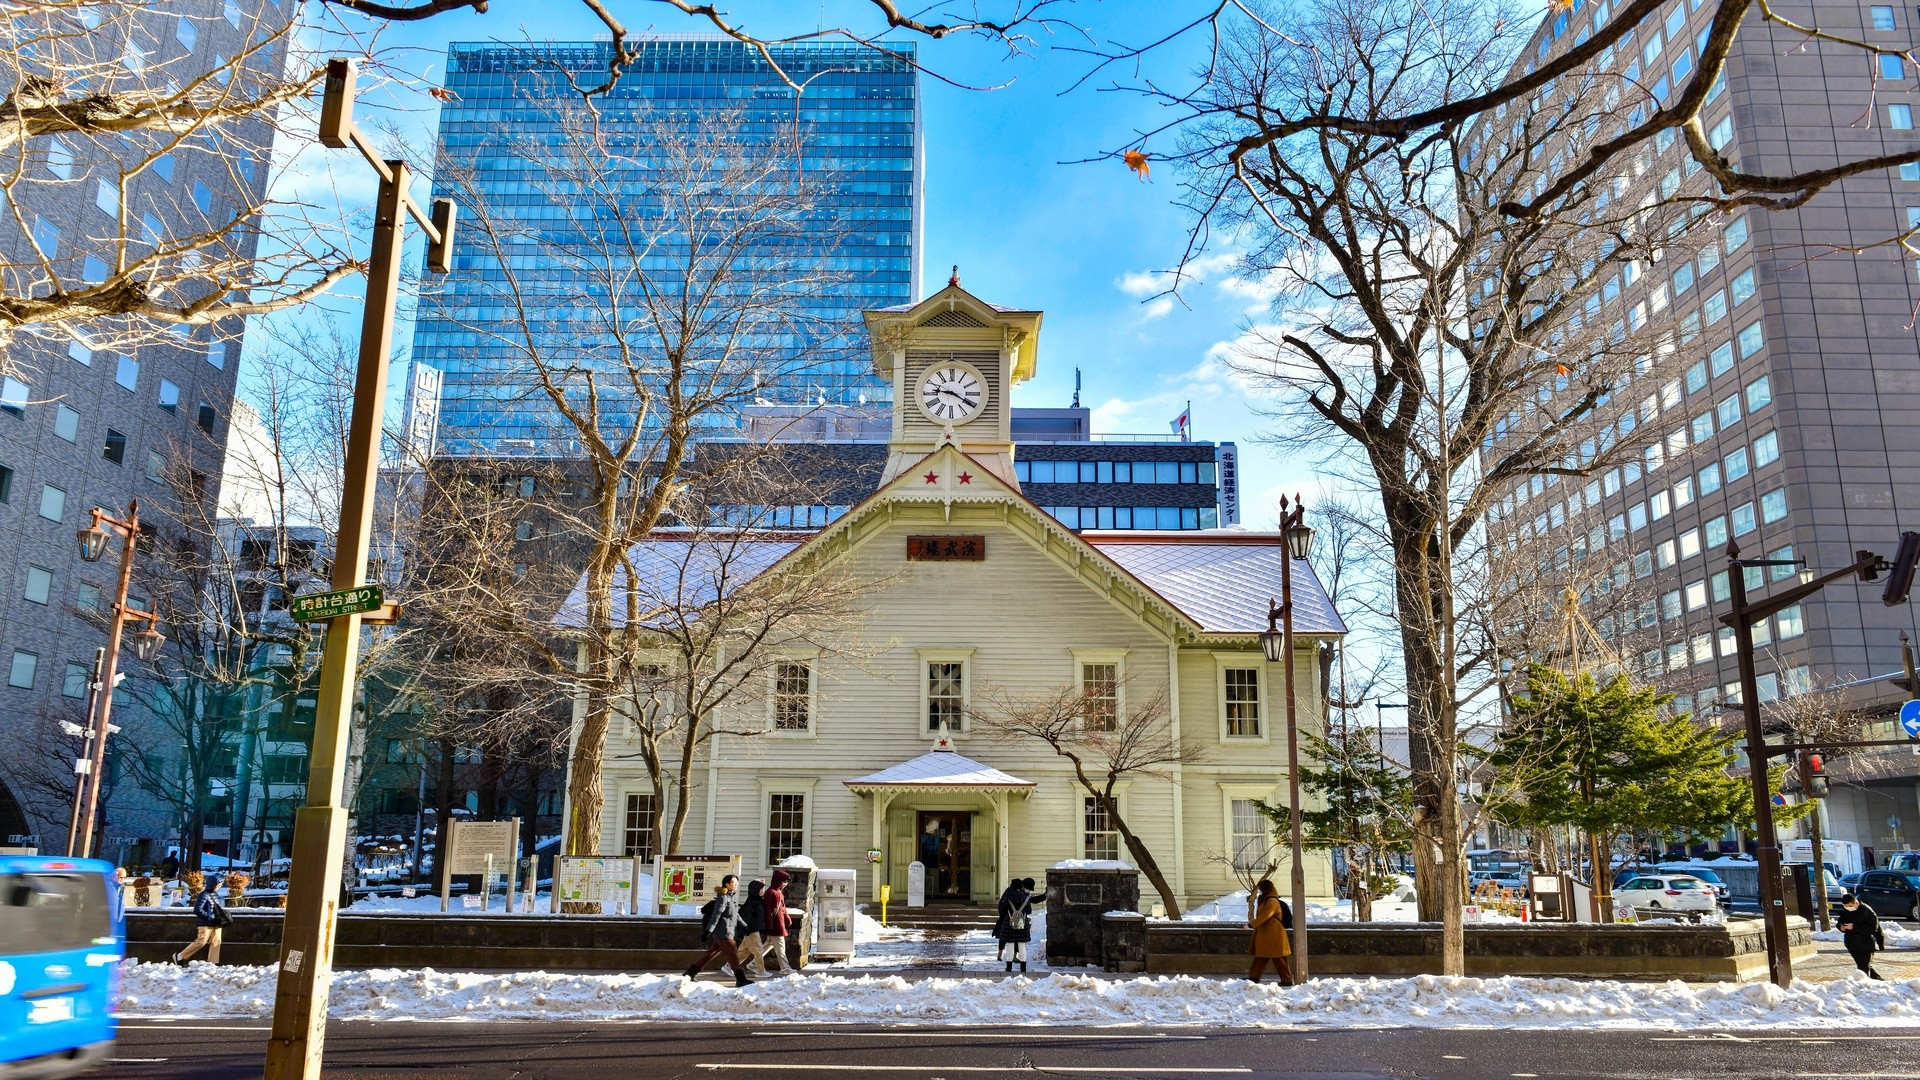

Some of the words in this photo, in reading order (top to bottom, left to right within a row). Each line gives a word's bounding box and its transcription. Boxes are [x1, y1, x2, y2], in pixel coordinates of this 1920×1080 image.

[958, 371, 967, 384] I
[1223, 452, 1236, 522] 北海道経済センター
[300, 589, 371, 611] 時計台通り
[306, 608, 338, 618] TOKEIDAI
[341, 602, 368, 613] STREET
